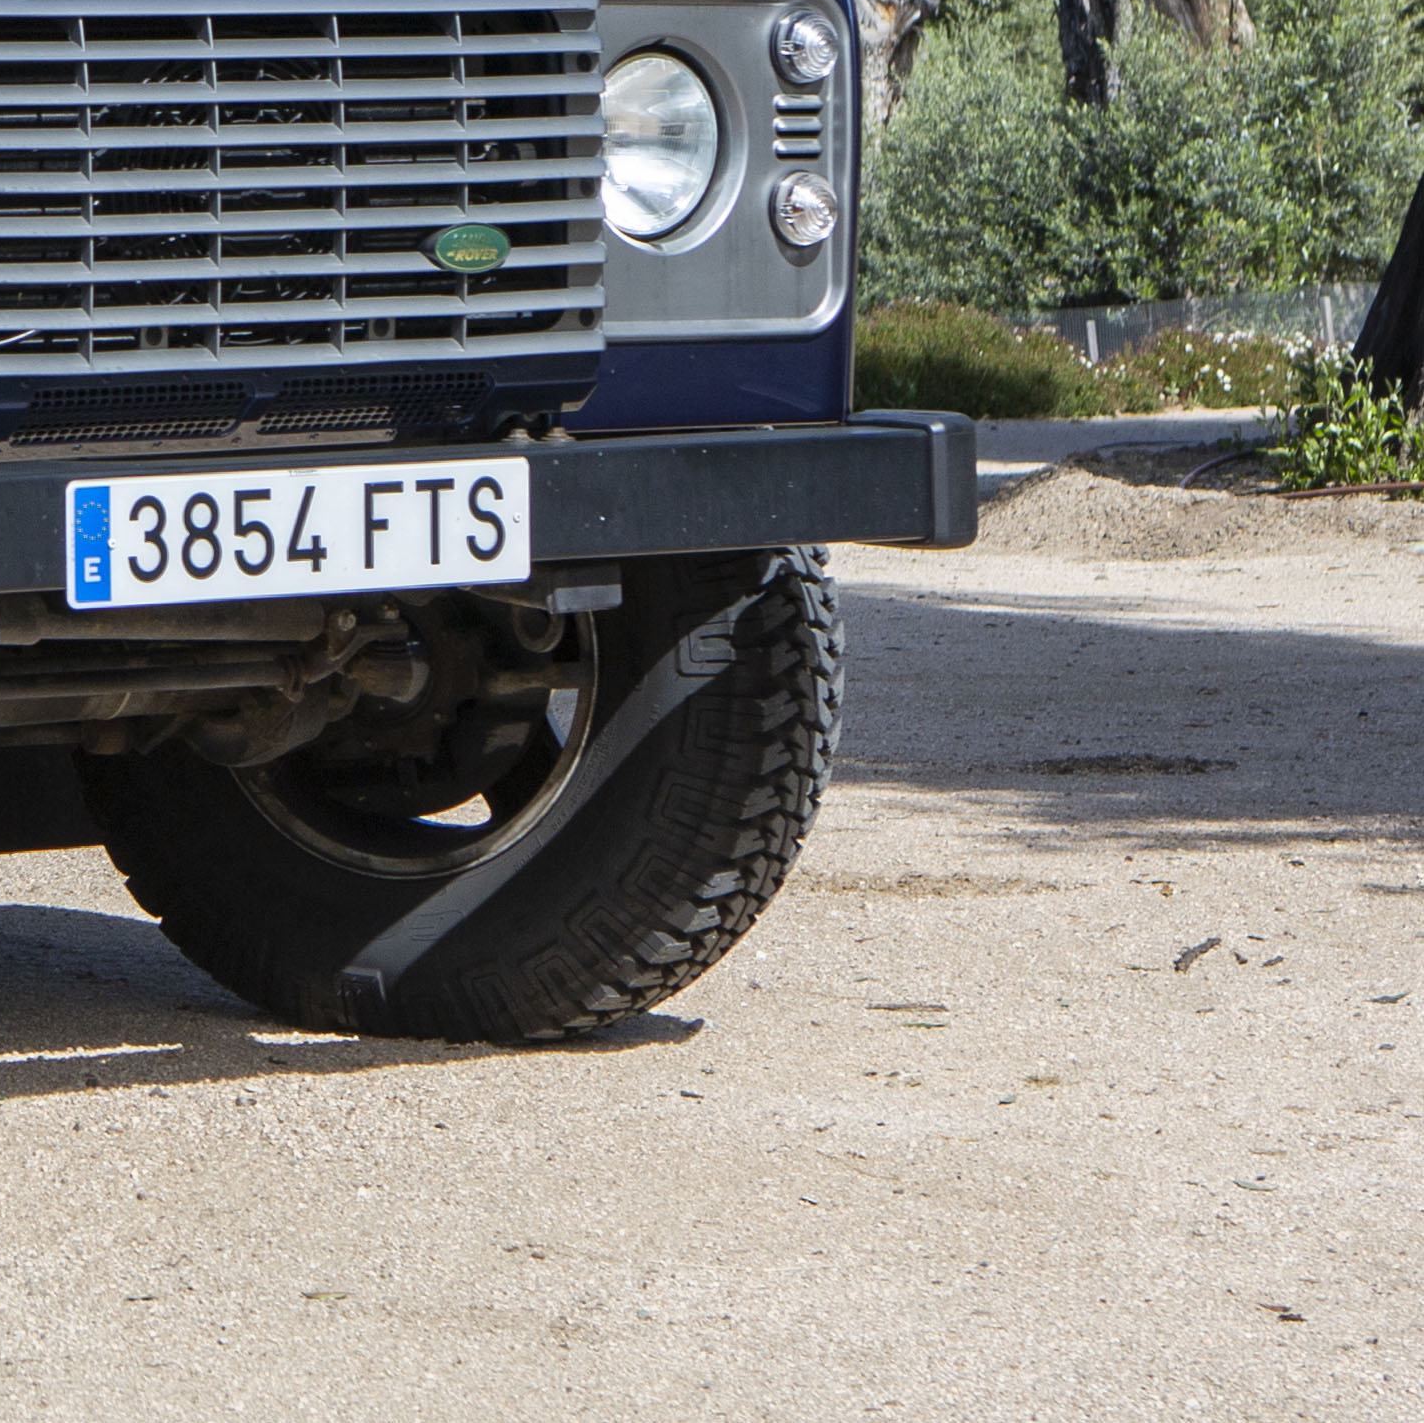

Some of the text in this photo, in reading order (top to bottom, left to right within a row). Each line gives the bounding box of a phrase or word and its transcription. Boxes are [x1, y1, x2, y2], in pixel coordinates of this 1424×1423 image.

[127, 475, 507, 584] 3854 FTS
[83, 556, 102, 584] E
